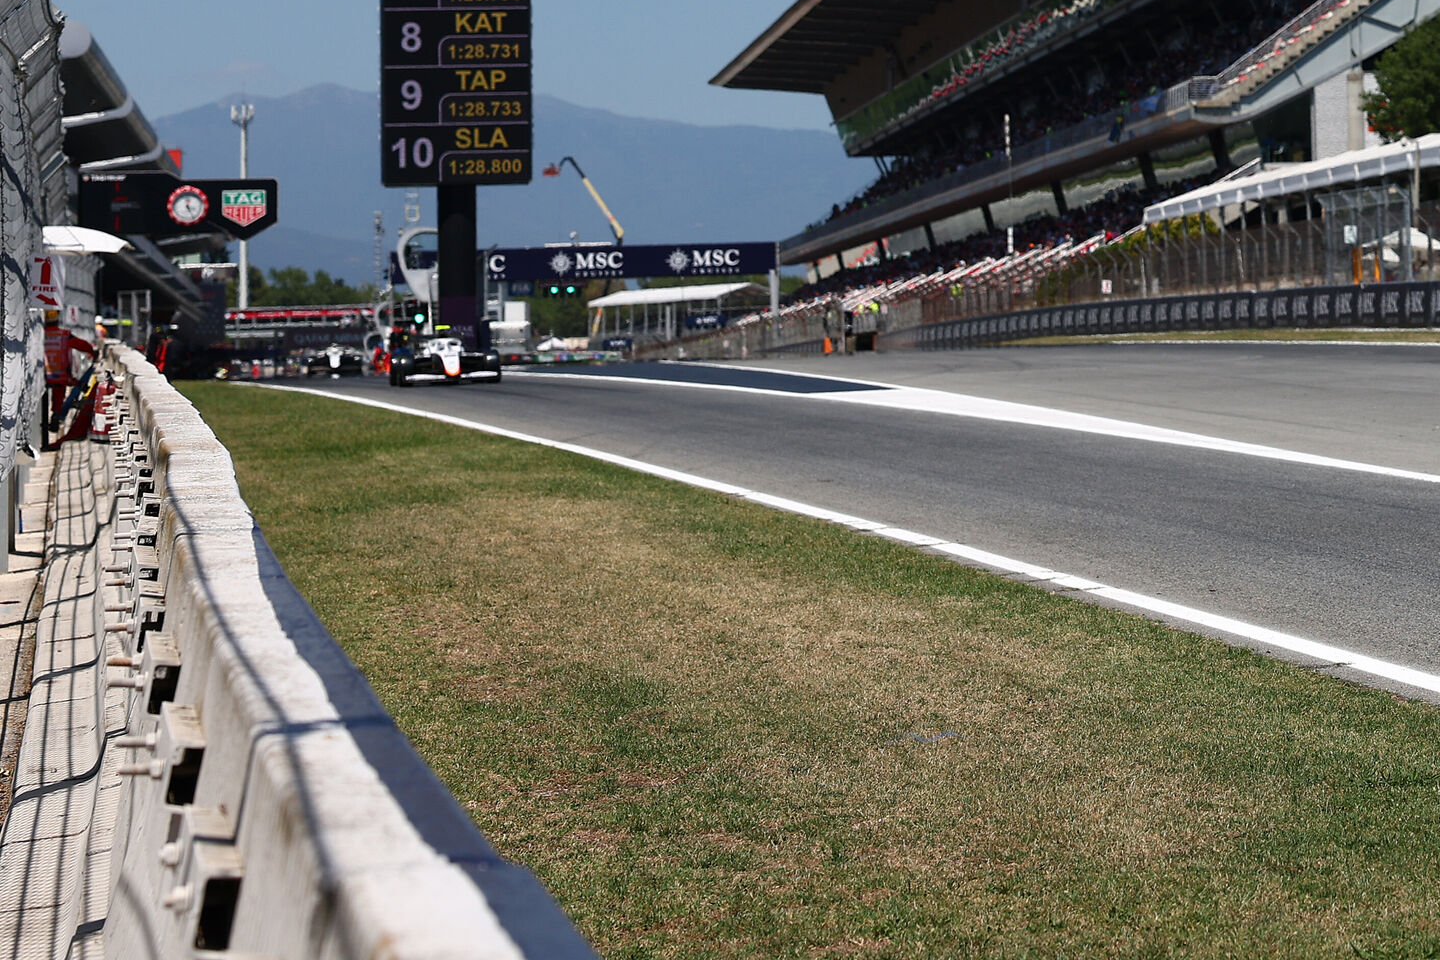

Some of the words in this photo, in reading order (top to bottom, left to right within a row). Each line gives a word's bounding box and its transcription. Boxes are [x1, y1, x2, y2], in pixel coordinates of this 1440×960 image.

[454, 12, 508, 33] KAT
[401, 22, 422, 52] 8
[448, 44, 521, 59] 1:28.731
[455, 70, 507, 91] TAP
[401, 79, 423, 111] 9
[449, 101, 522, 117] 1:28.733
[455, 127, 509, 149] SLA
[391, 137, 434, 169] 10
[449, 159, 523, 175] 1:28.800
[228, 191, 262, 203] TAG
[575, 251, 624, 270] MSC
[692, 248, 740, 267] MSC
